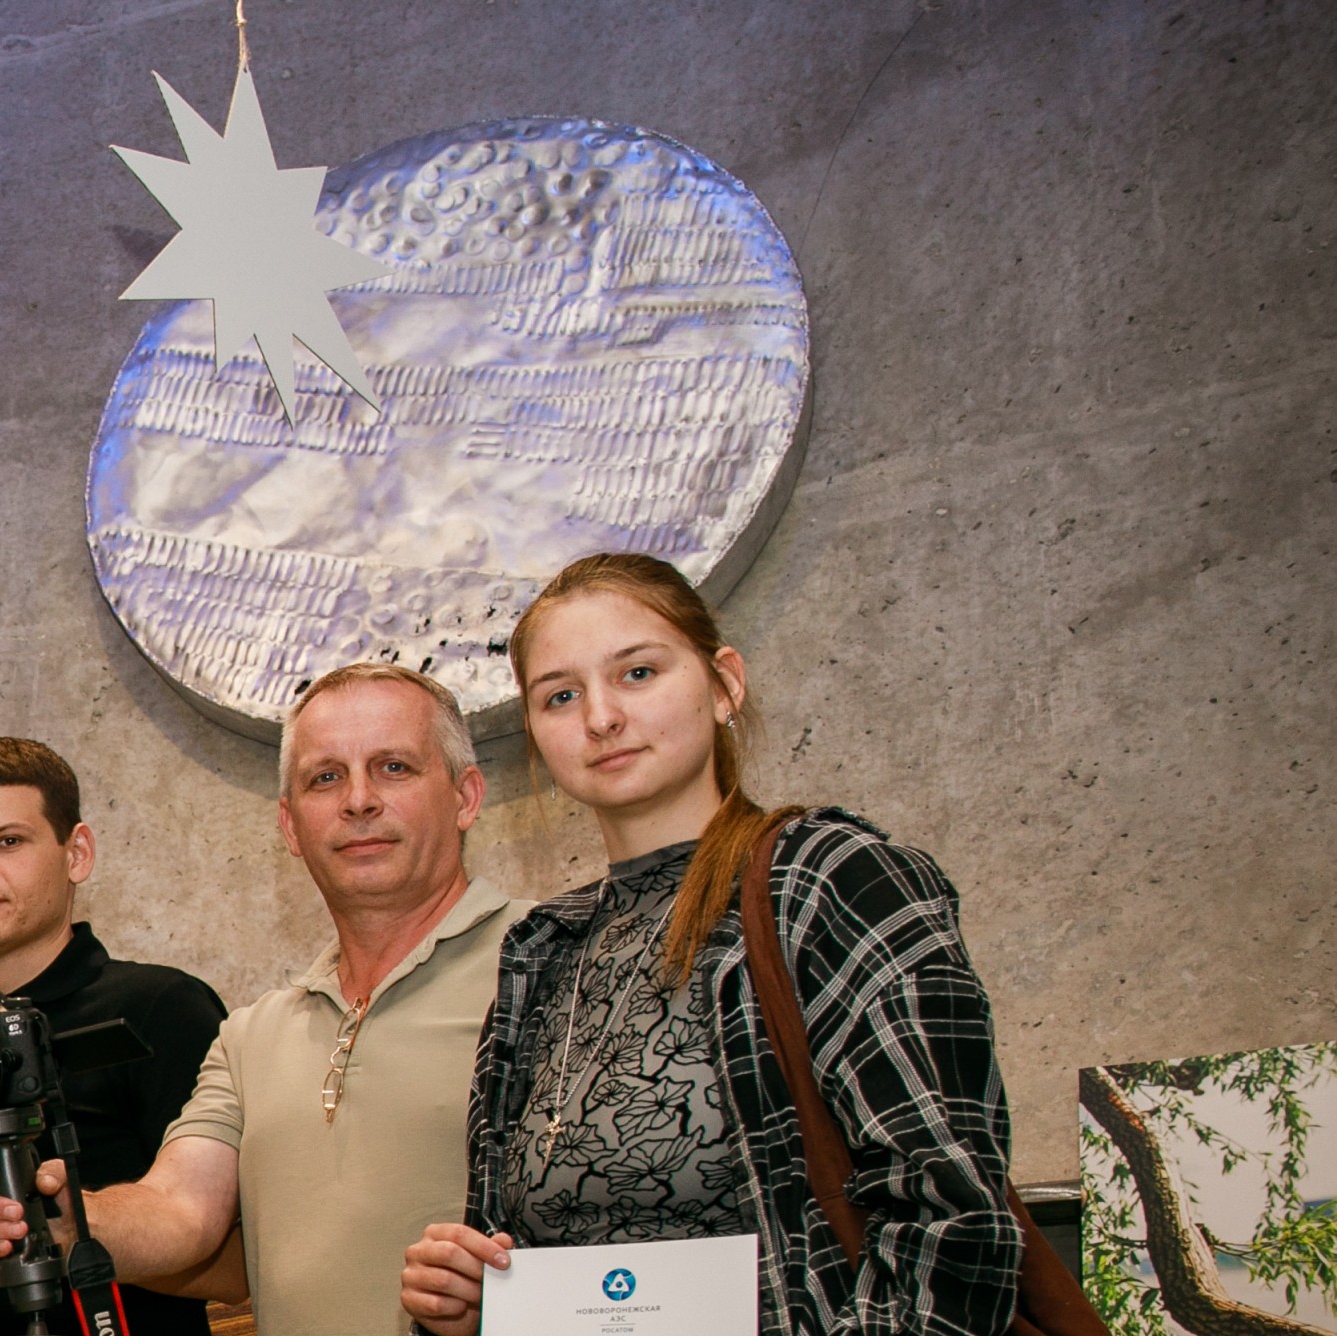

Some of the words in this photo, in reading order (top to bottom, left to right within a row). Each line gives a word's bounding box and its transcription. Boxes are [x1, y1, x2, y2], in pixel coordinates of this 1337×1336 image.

[5, 1014, 21, 1023] EOS
[575, 1304, 662, 1316] НОВОВОРОНЕЖСКАЯ
[601, 1326, 635, 1334] РОСАТОМ
